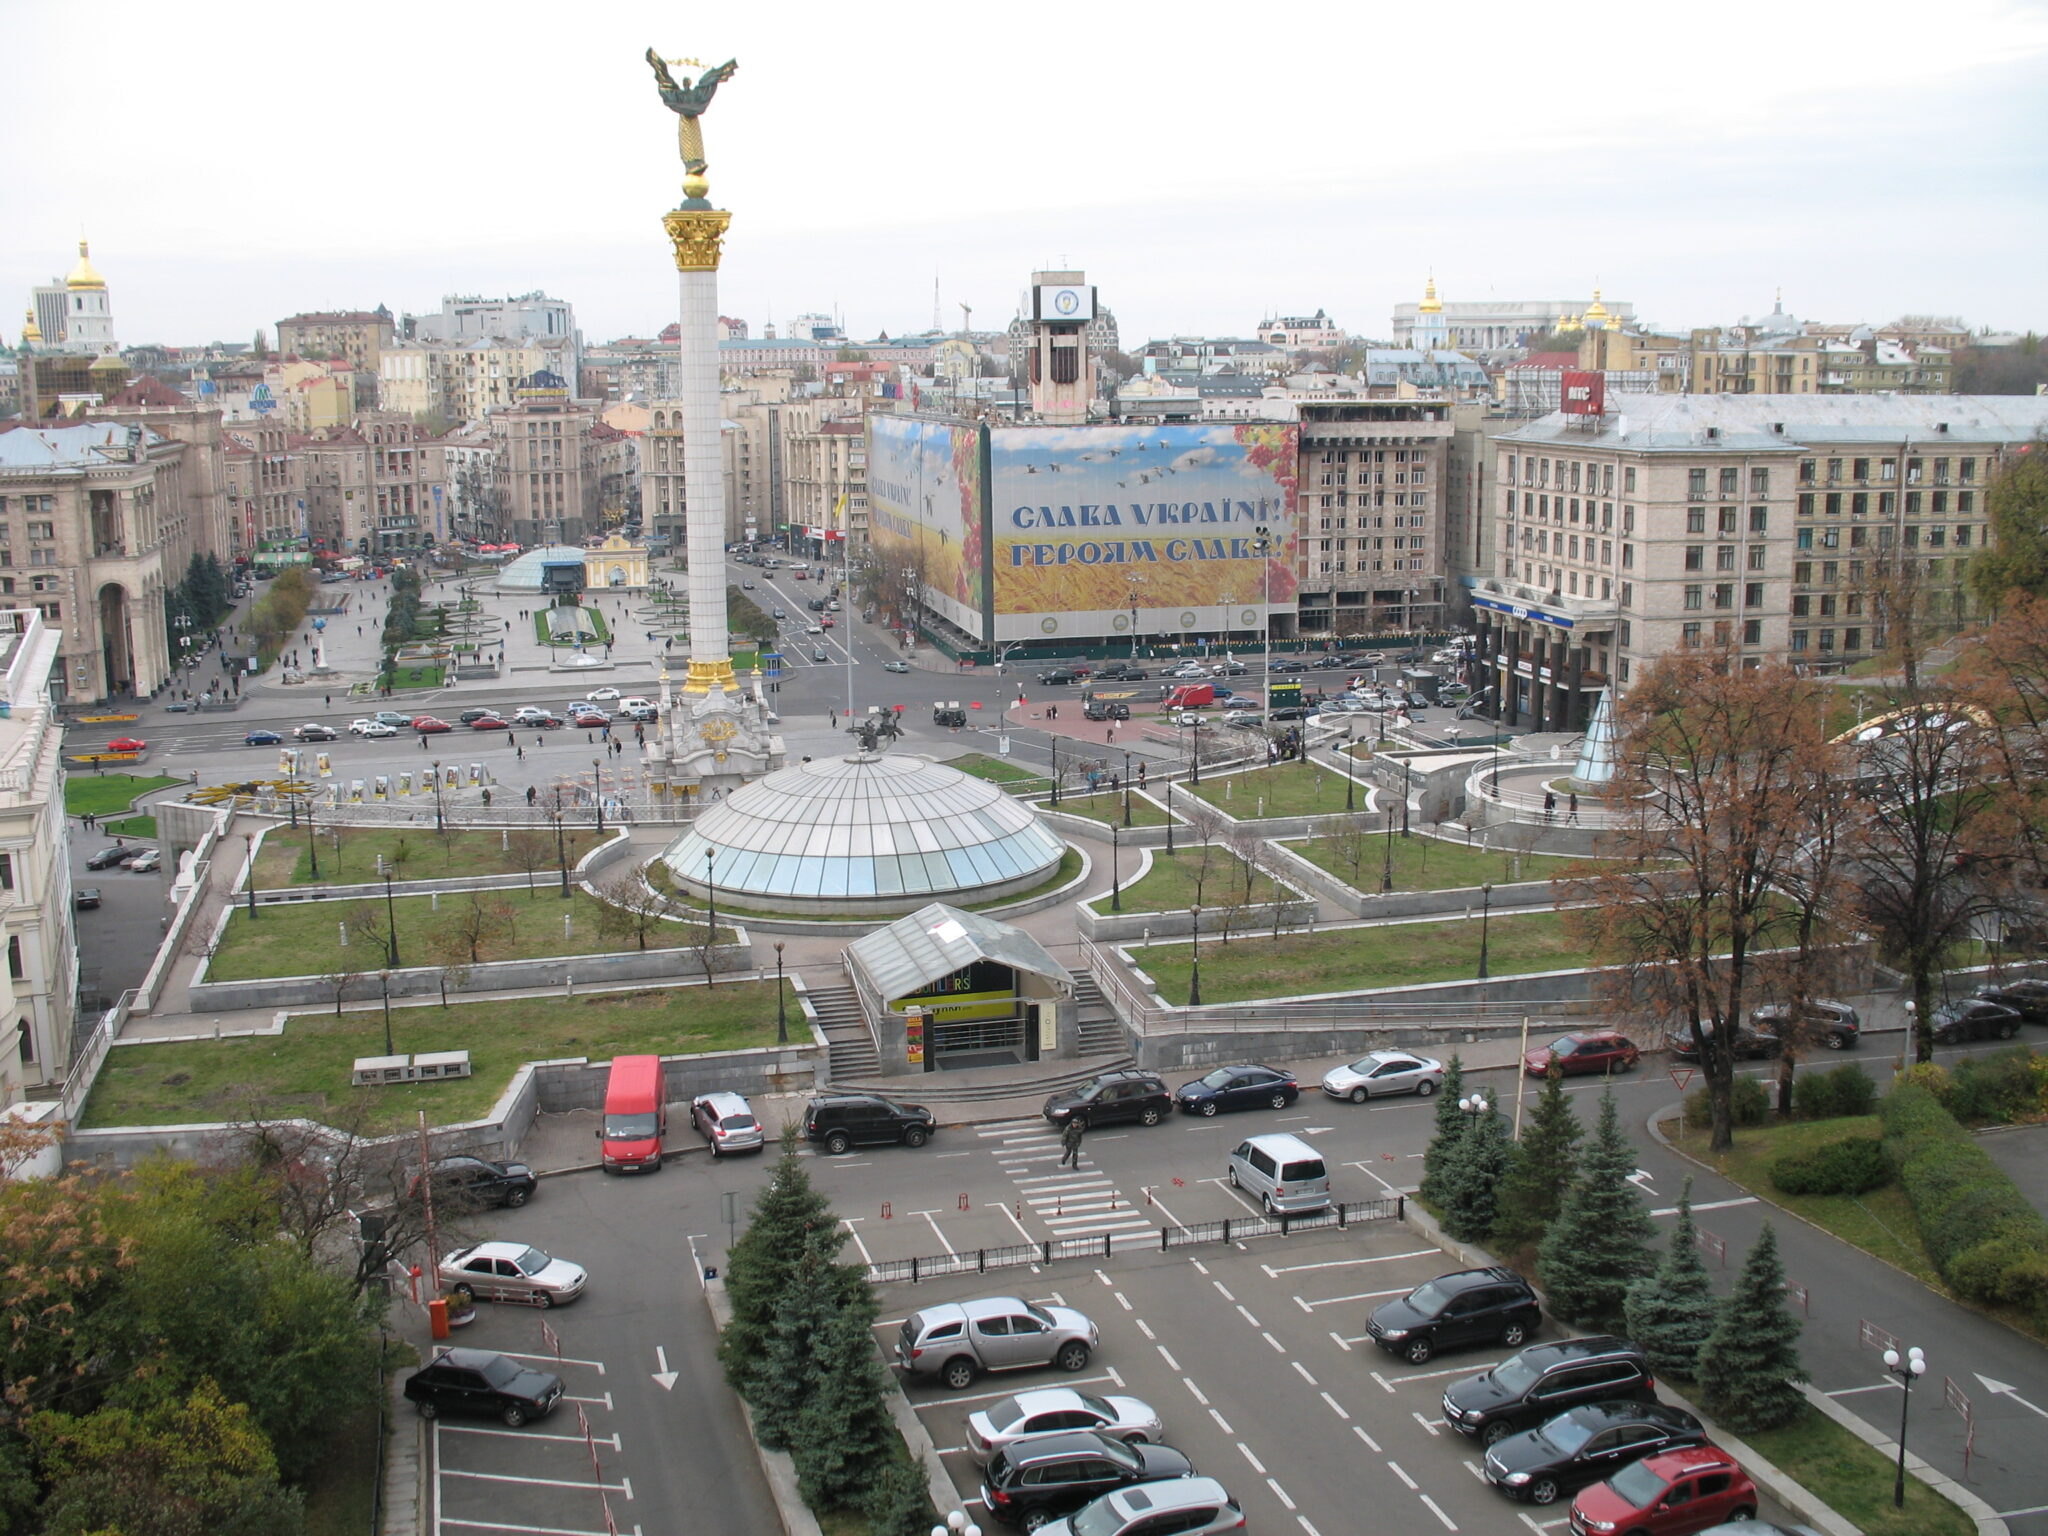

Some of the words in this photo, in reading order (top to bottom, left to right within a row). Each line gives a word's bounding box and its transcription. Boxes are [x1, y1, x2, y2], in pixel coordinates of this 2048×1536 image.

[1012, 504, 1121, 528] СЛАВА
[1130, 498, 1281, 527] УКРАЇНІ!
[1011, 541, 1157, 567] ГЕРОЯМ
